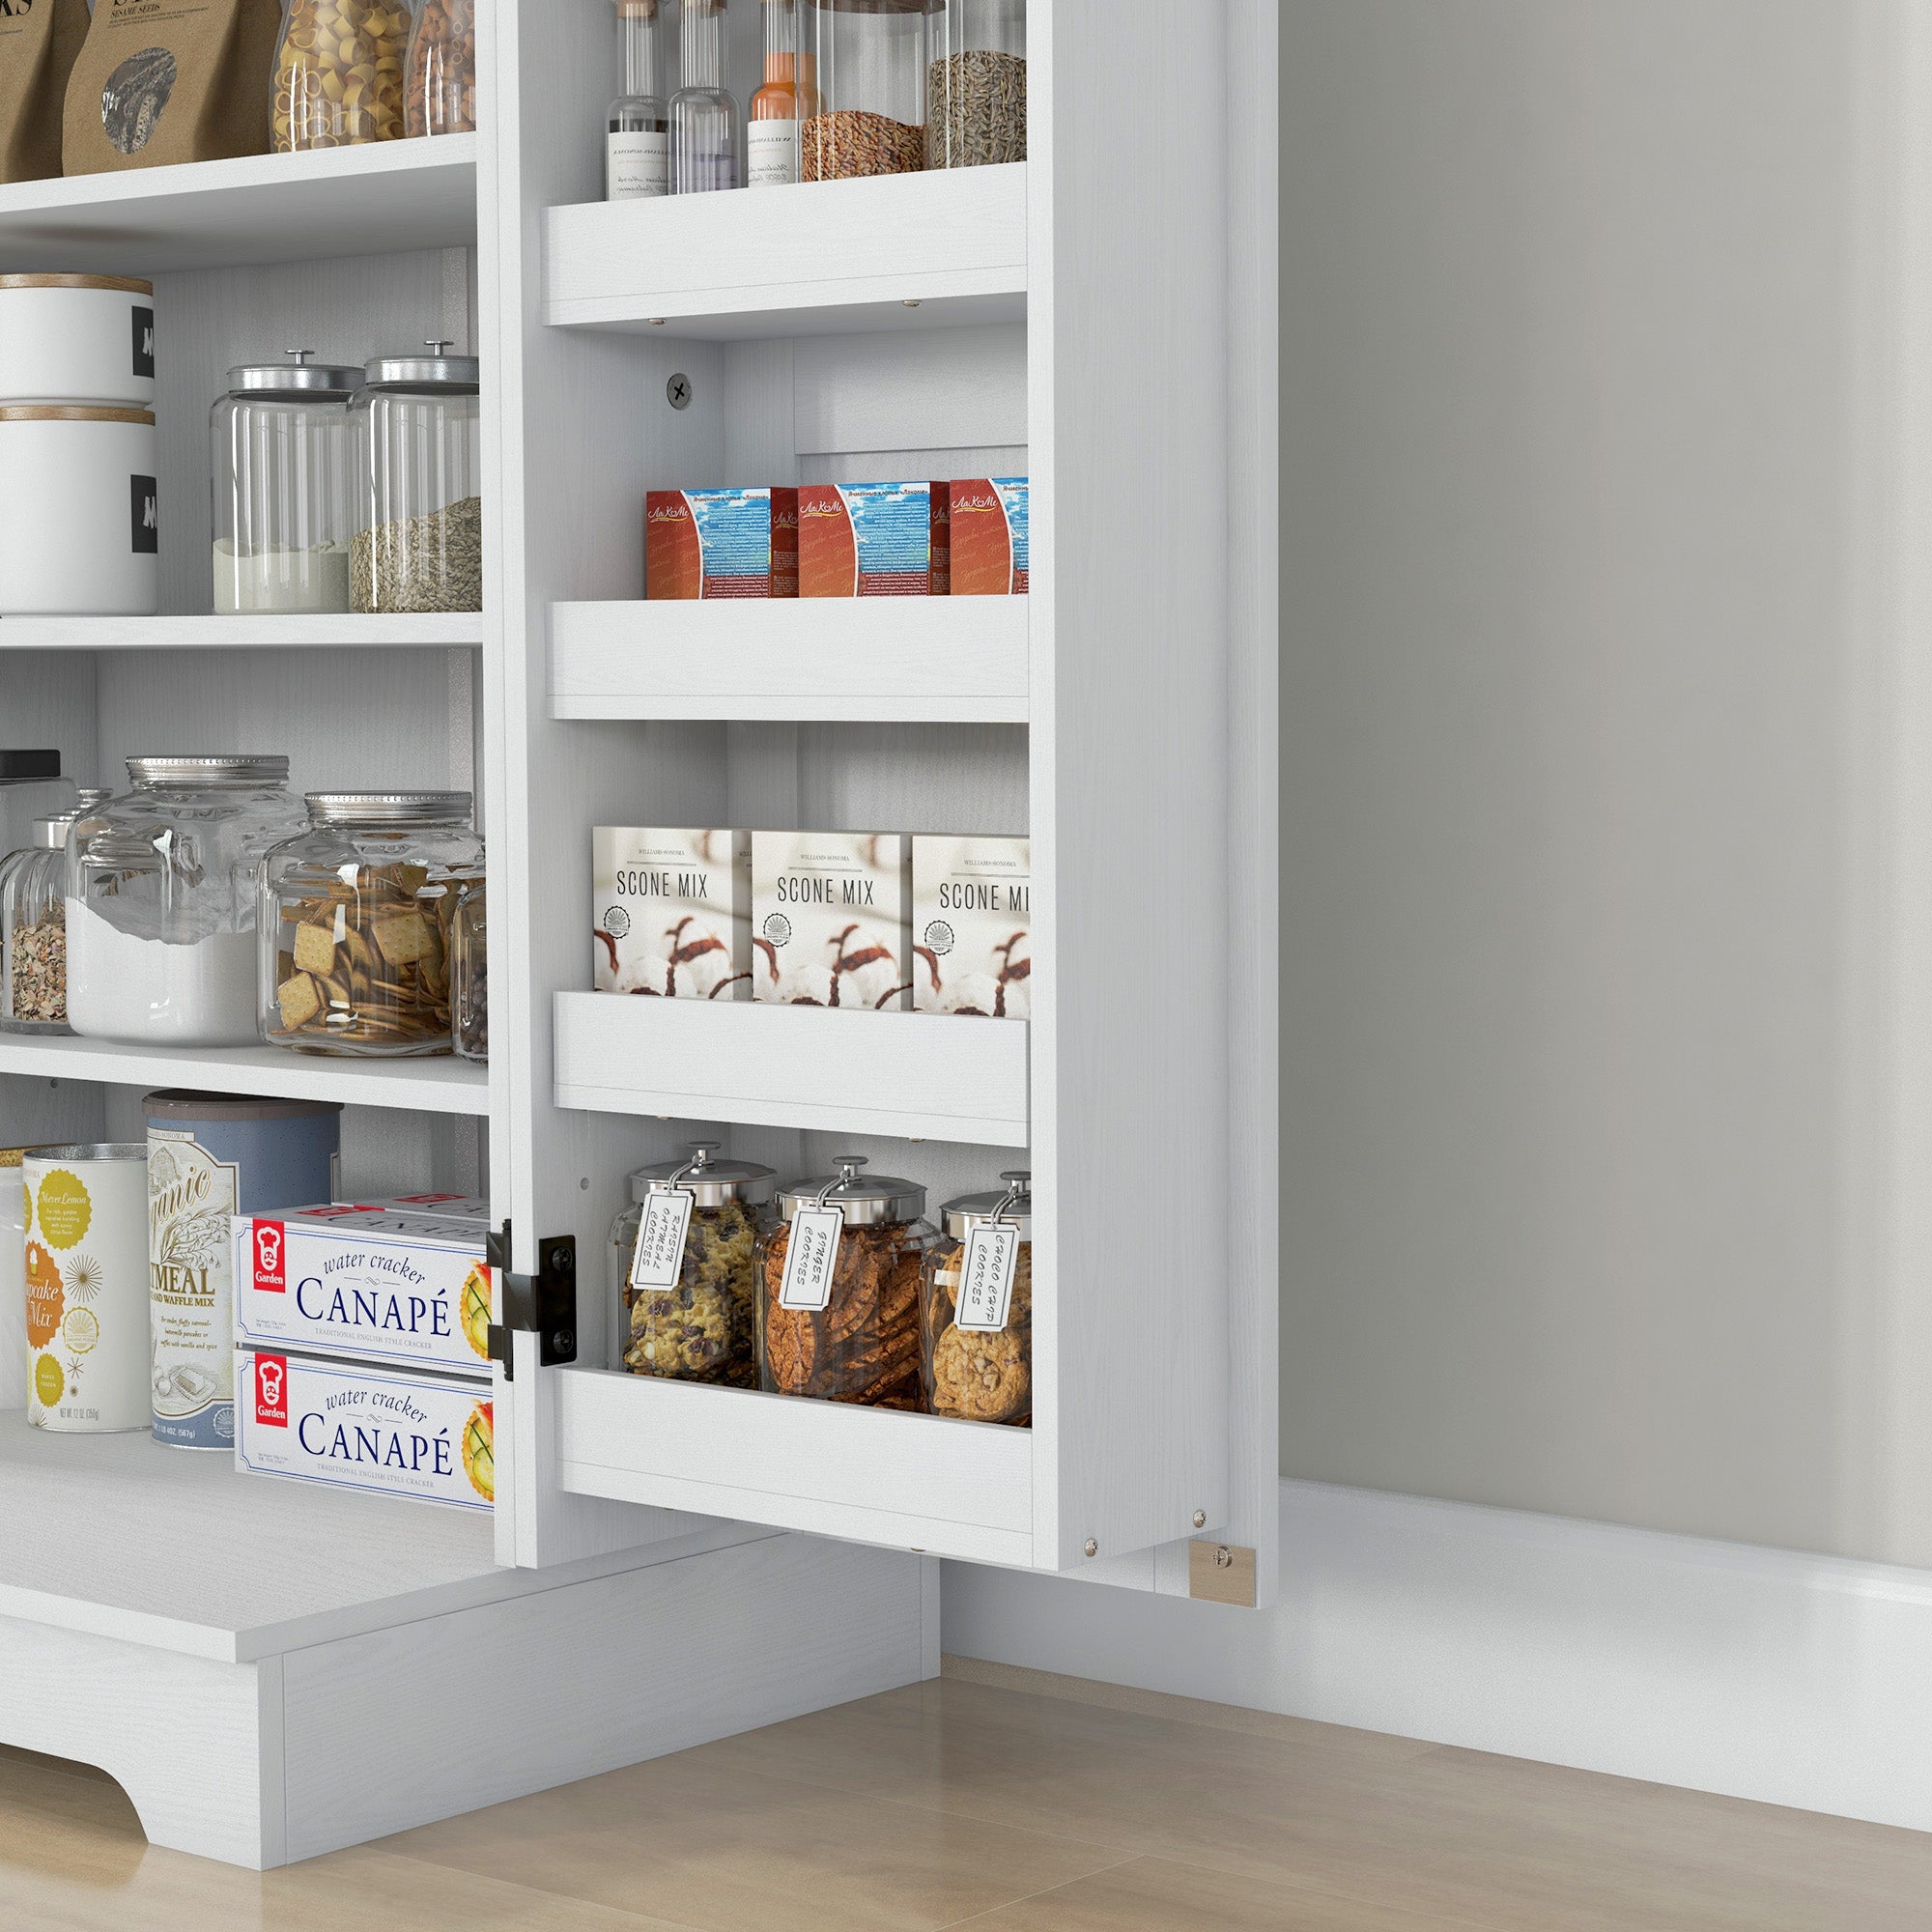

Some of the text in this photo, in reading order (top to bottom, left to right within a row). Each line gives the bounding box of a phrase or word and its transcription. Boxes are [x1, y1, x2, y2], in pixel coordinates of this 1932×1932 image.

[111, 7, 136, 17] SESAME
[139, 4, 160, 13] SEEDS
[617, 870, 708, 898] SCONE MIX
[778, 876, 873, 905] SCONE MIX
[939, 883, 1029, 911] SCONE MI
[61, 1192, 86, 1205] Lemon
[642, 1211, 659, 1266] COOKIES
[653, 1208, 670, 1269] OATMEAL
[666, 1214, 680, 1263] RAISIN
[324, 1253, 427, 1286] water cracker
[797, 1226, 813, 1286] COOKIES
[810, 1231, 828, 1285] GINGER
[255, 1271, 284, 1286] Garden
[972, 1244, 988, 1305] COOKIES
[985, 1235, 1006, 1322] CHOCO CHIP
[30, 1300, 53, 1327] Mix
[163, 1294, 193, 1306] WAFFLE
[194, 1298, 215, 1307] MIX
[297, 1277, 451, 1337] CANAPÉ
[315, 1328, 432, 1350] TRADITIONAL ENGLISH STYLE CRACKER
[257, 1406, 286, 1419] Garden
[326, 1390, 428, 1424] water cracker
[178, 1430, 196, 1438] (567g)
[298, 1413, 453, 1476] CANAPÉ
[317, 1463, 435, 1488] TRADITIONAL ENGLISH STYLE CRACKER
